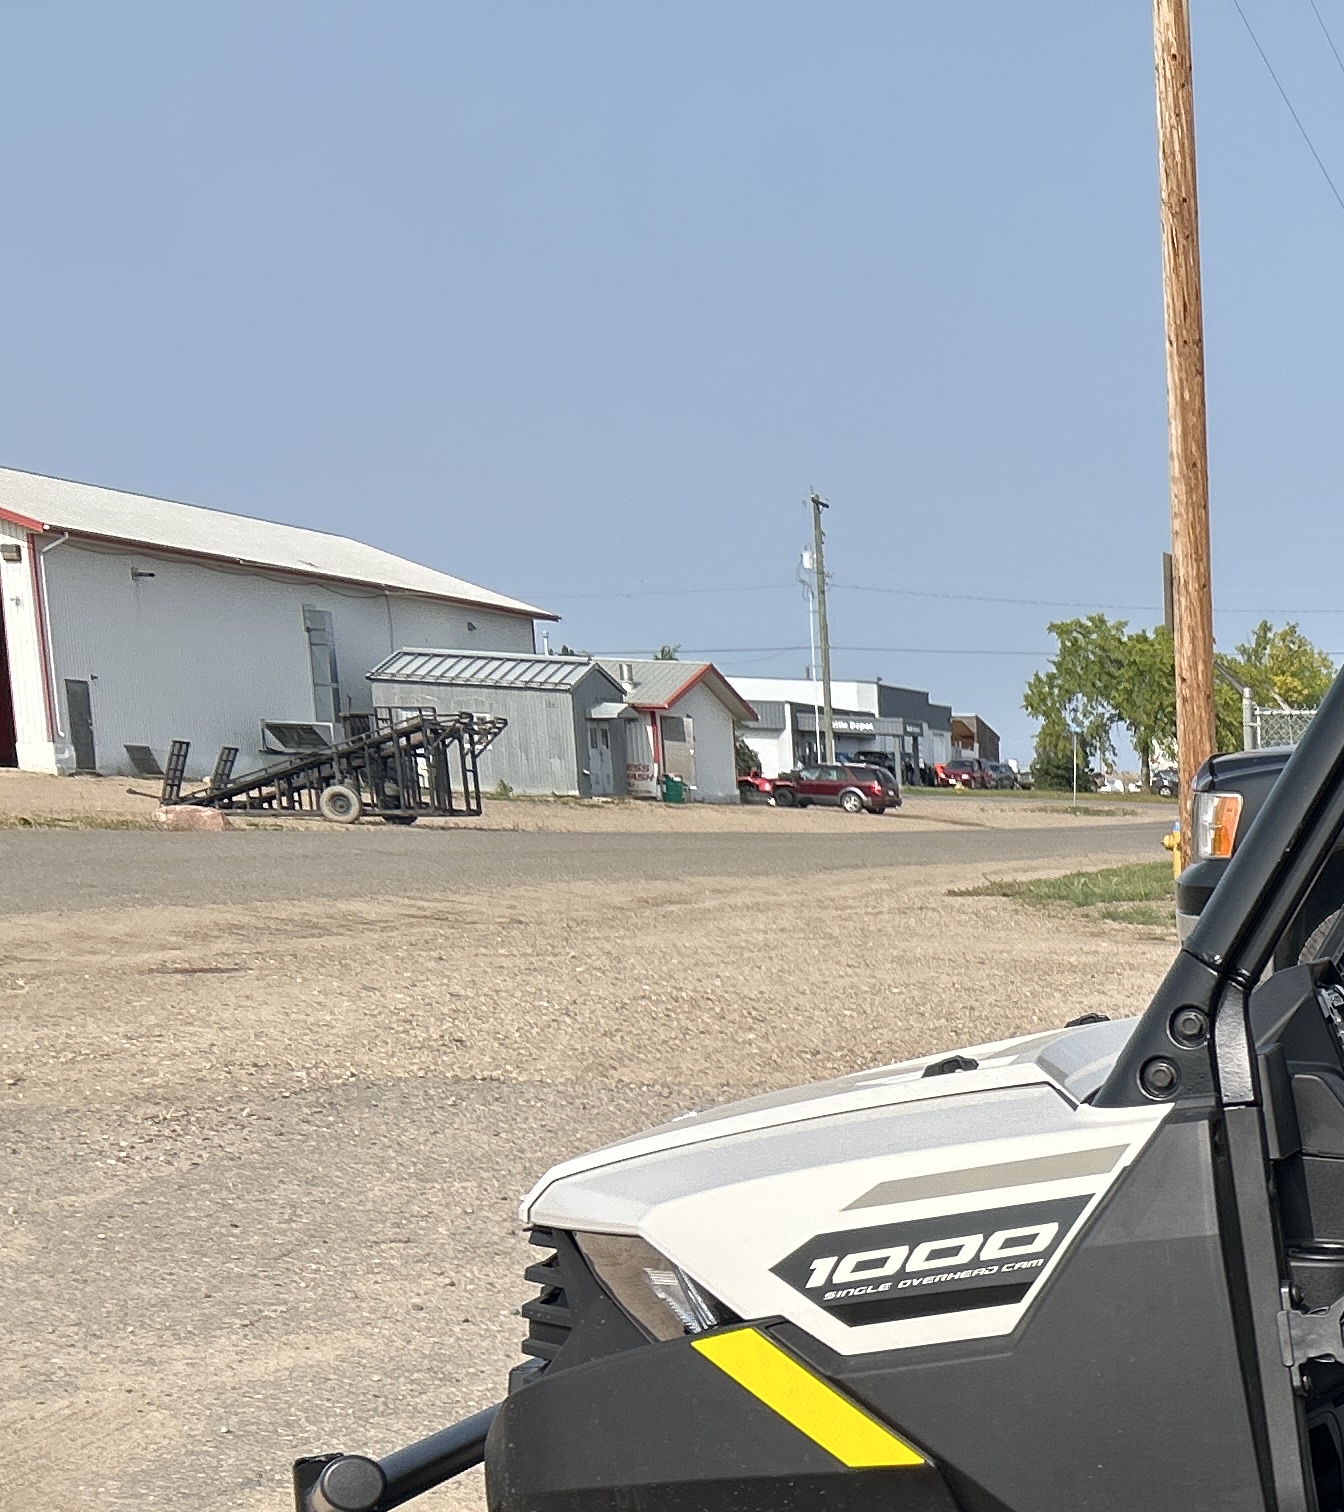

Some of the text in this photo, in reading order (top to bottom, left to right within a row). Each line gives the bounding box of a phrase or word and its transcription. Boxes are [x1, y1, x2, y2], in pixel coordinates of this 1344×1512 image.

[805, 1222, 1059, 1288] 1000
[823, 1258, 1045, 1301] SINGLE OVERHEAD CAM
